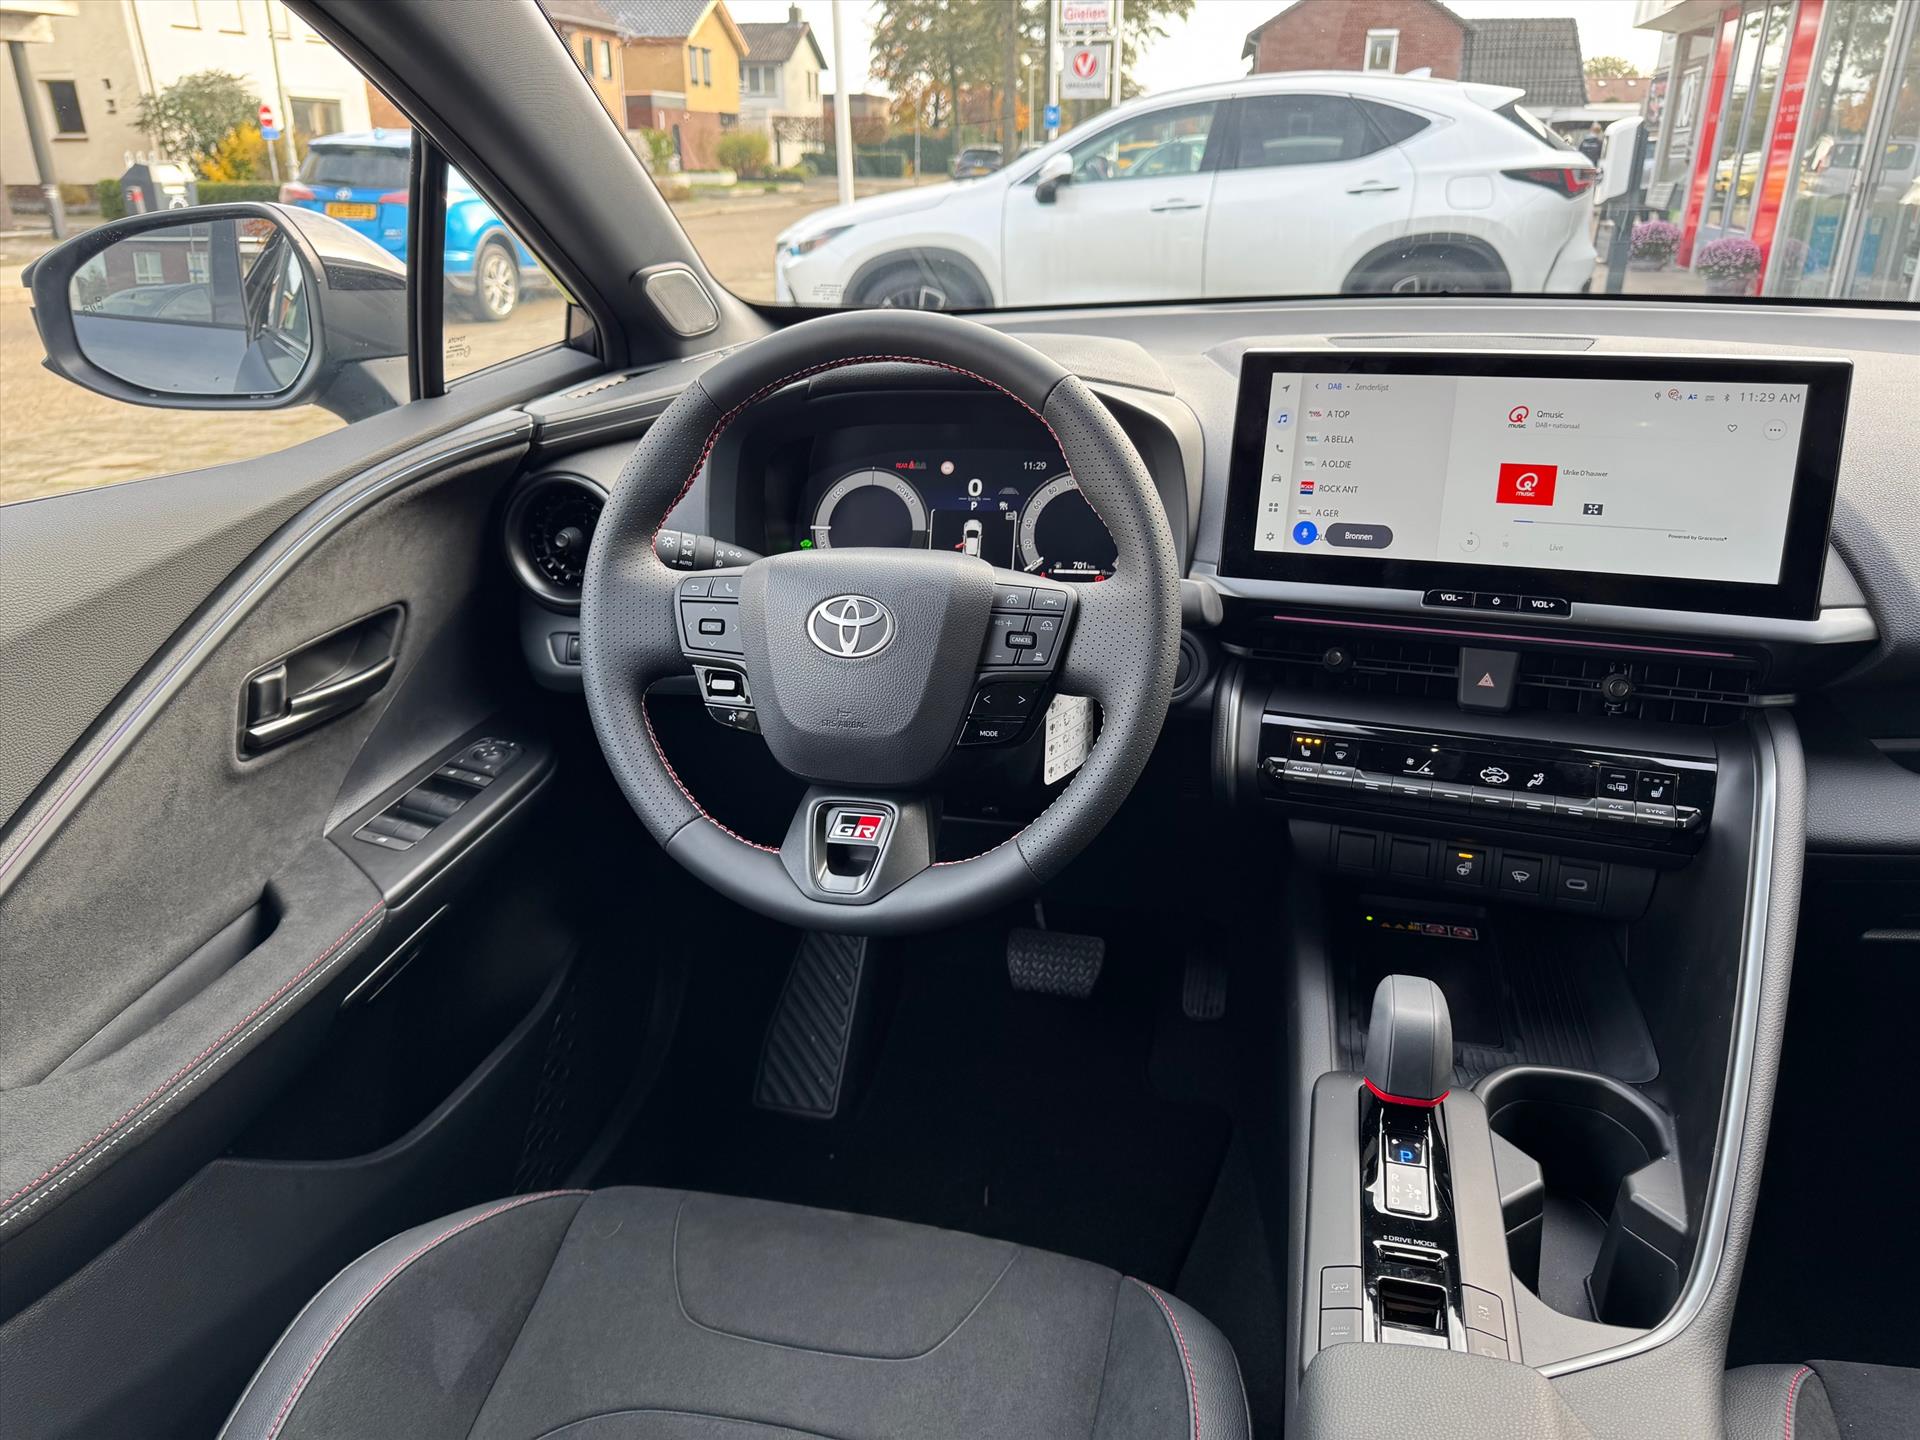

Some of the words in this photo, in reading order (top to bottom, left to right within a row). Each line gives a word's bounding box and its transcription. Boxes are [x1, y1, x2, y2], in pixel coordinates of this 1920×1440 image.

[1327, 382, 1343, 390] DAB
[1354, 384, 1390, 393] Zenderlijst
[1740, 392, 1776, 403] 11:29
[1779, 393, 1801, 403] AM
[1334, 410, 1350, 418] TOP
[1536, 410, 1564, 419] Qmusic
[1331, 436, 1354, 444] BELLA
[1023, 461, 1047, 470] 11:29
[1328, 460, 1352, 469] OLDIE
[967, 478, 983, 497] 0
[1318, 485, 1341, 493] ROCK
[1342, 486, 1359, 494] ANT
[896, 484, 916, 505] POWER
[970, 501, 978, 511] P
[1323, 510, 1339, 518] GER
[1344, 531, 1374, 541] Bronnen
[1549, 543, 1564, 552] Live
[678, 559, 693, 567] AUTO
[1072, 561, 1087, 570] 701
[1400, 1150, 1414, 1164] P
[1388, 1234, 1413, 1245] DRIVE
[1413, 1238, 1439, 1249] MODE
